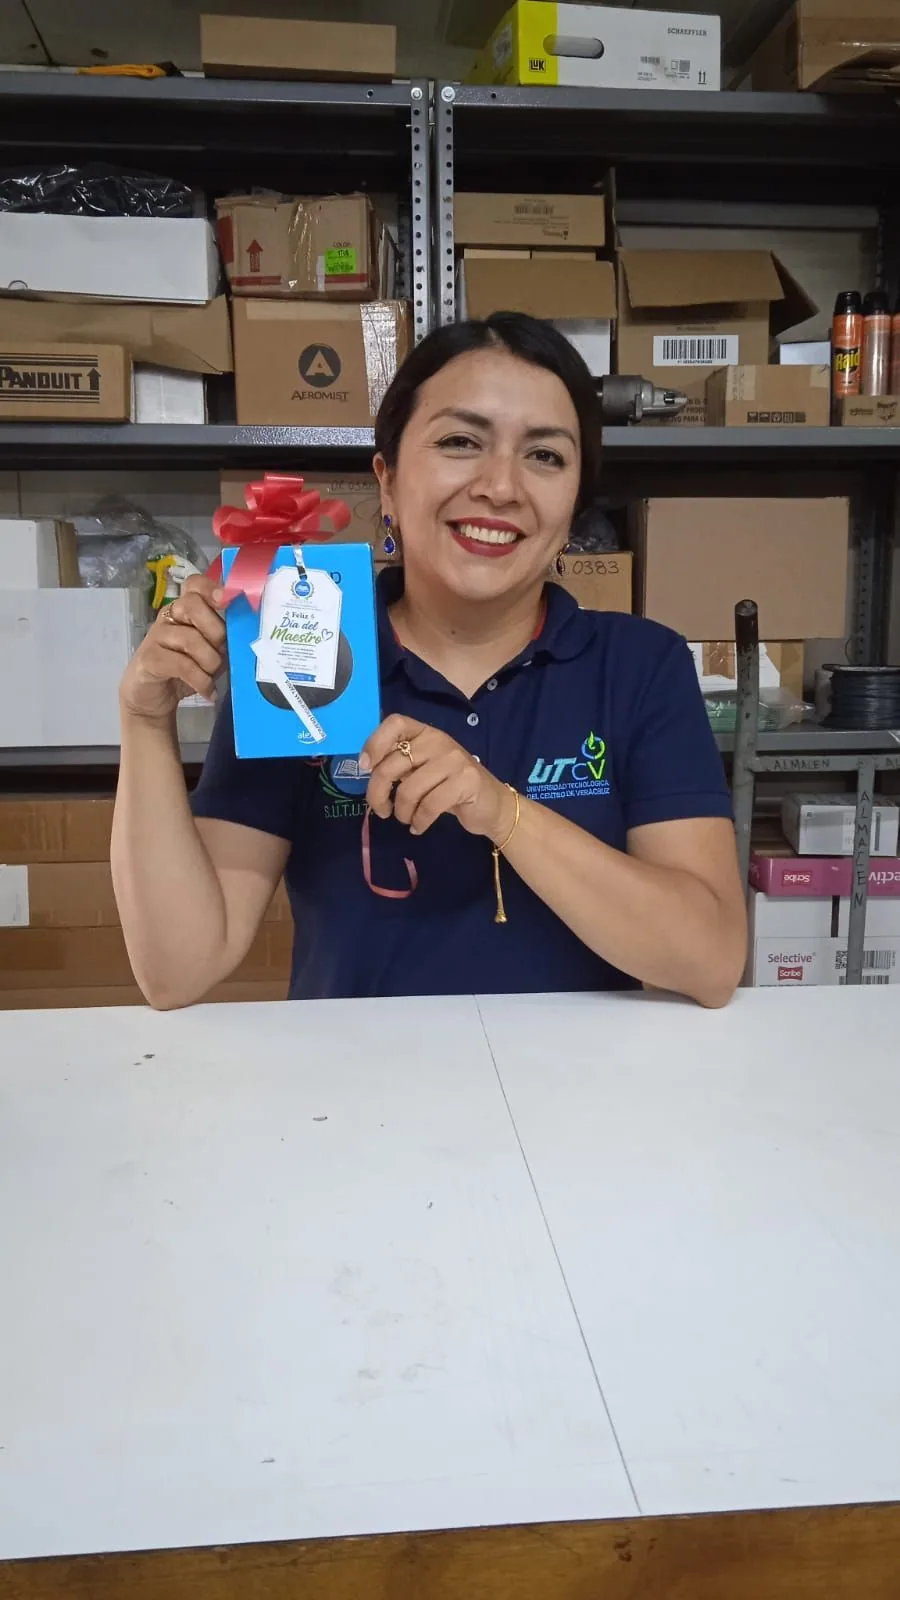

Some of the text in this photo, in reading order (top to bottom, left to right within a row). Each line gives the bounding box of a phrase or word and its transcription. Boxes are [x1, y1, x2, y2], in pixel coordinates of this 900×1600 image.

[0, 366, 82, 390] PANDUIT
[291, 389, 350, 401] AEROMIST
[572, 560, 619, 575] 0383
[292, 611, 309, 620] Feliz
[301, 620, 319, 631] del
[270, 624, 322, 645] Maestro
[526, 783, 567, 793] UNIVERSIDAD
[540, 790, 566, 800] CENTRO
[566, 789, 575, 797] DE
[575, 787, 610, 797] VERACRUZ
[783, 871, 811, 883] Scribe
[768, 953, 812, 963] Selective
[780, 969, 801, 977] Scribe
